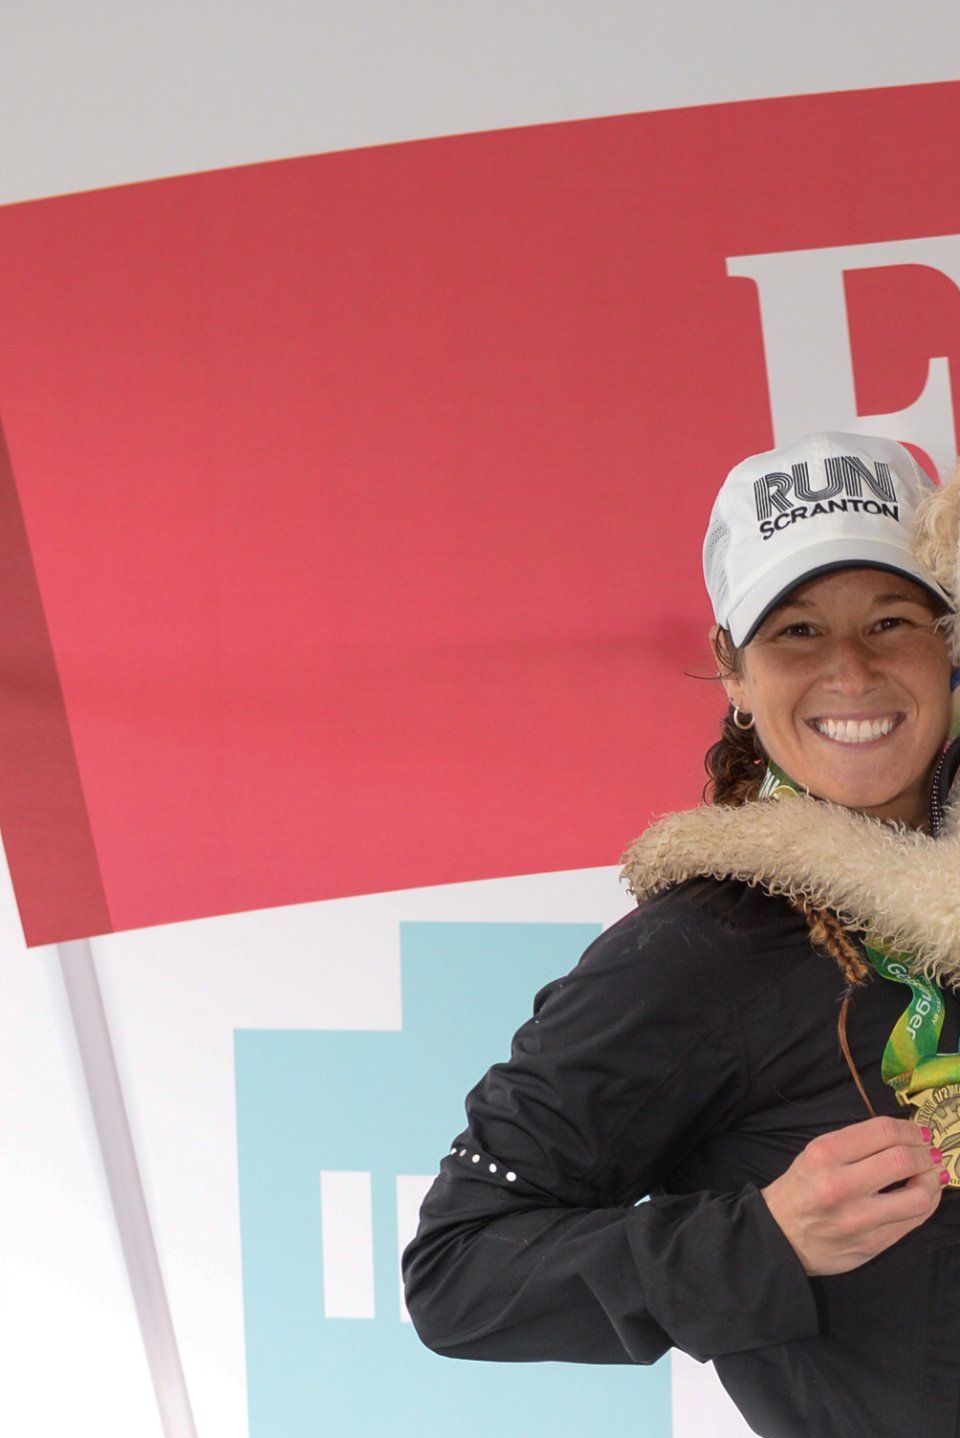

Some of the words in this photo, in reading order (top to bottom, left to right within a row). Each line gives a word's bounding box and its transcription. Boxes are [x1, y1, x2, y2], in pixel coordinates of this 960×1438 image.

[753, 455, 897, 521] RUN
[759, 498, 900, 541] SCRANTON
[933, 1086, 949, 1103] 1/2
